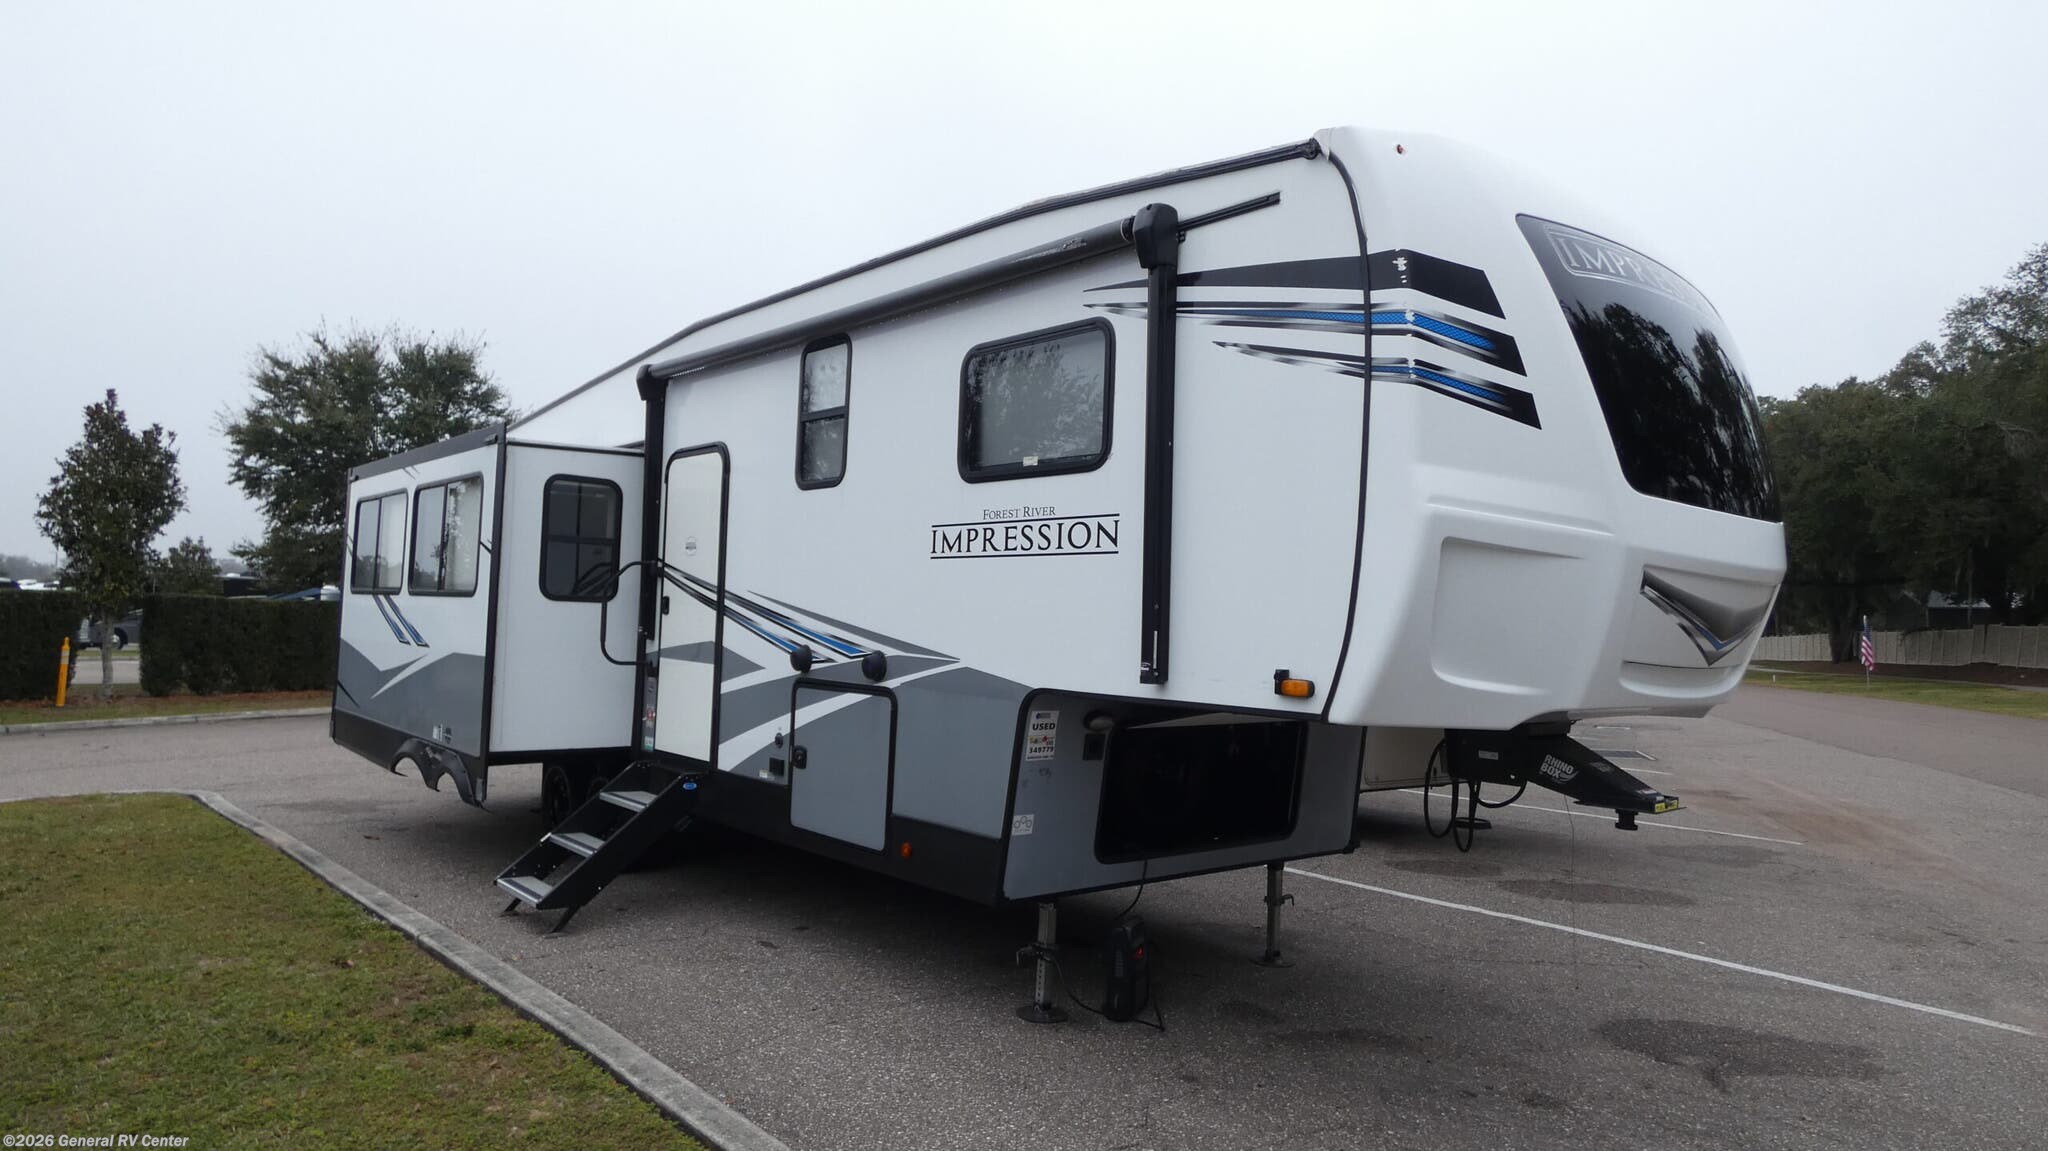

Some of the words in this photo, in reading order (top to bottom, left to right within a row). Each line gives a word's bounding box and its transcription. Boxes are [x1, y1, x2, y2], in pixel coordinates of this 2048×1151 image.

[983, 508, 1021, 520] FOREST
[1023, 506, 1057, 518] RIVER
[930, 520, 1120, 554] IMPRESSION
[1032, 722, 1056, 731] USED
[1540, 762, 1561, 779] BOX
[1544, 754, 1575, 775] RHINO
